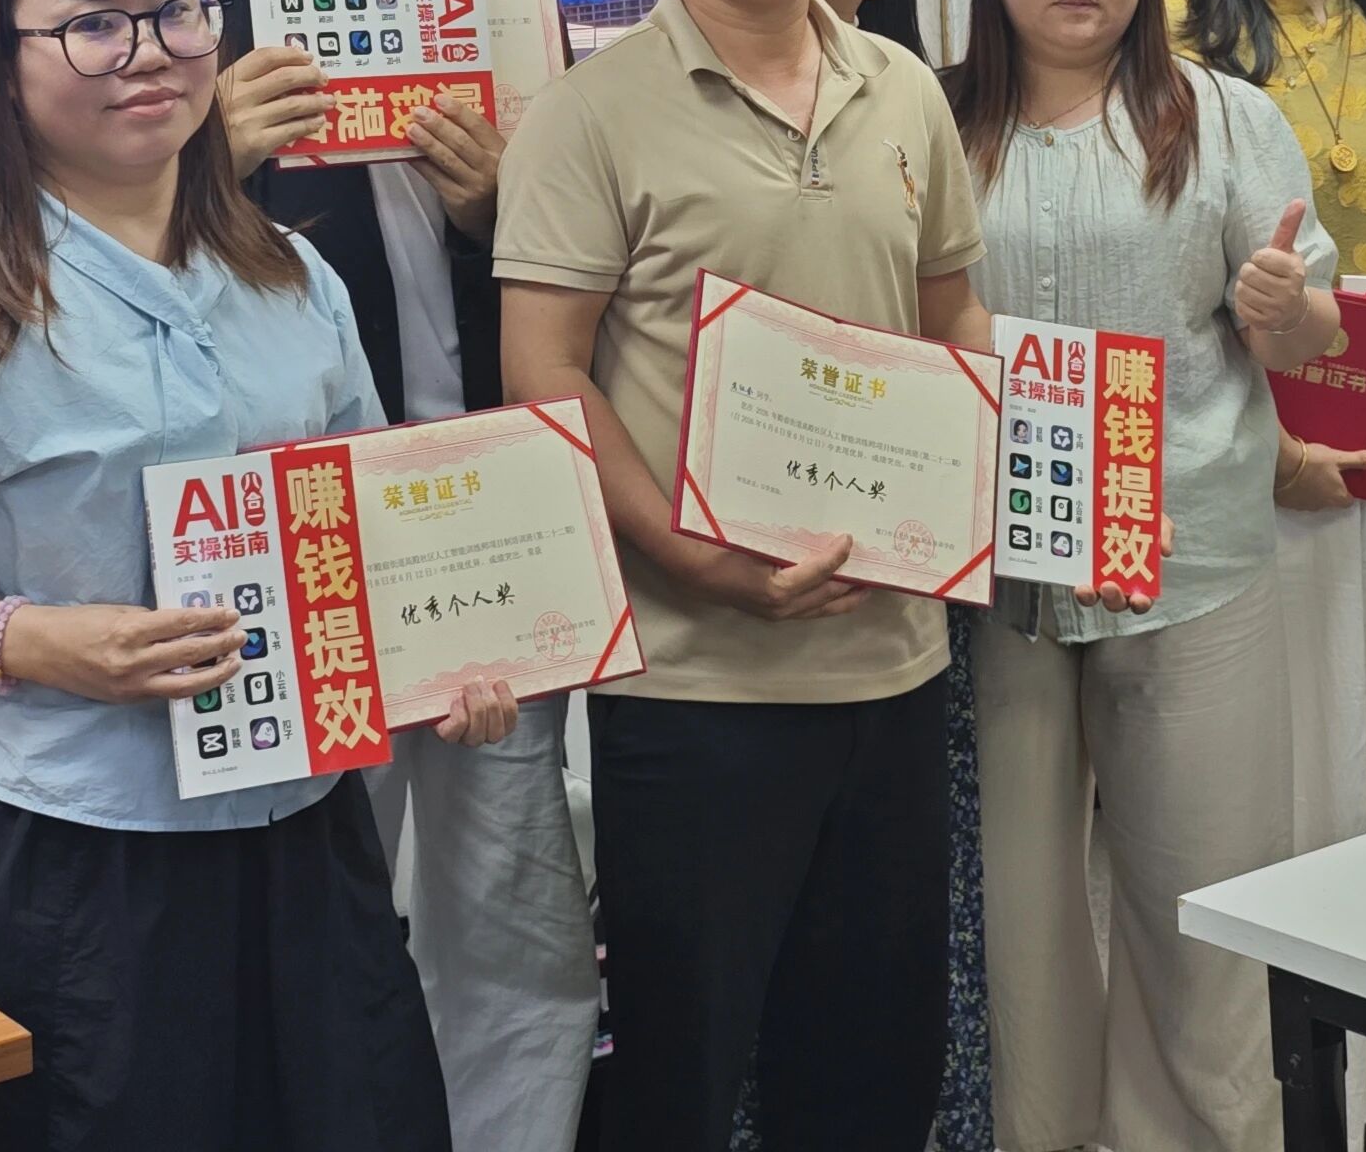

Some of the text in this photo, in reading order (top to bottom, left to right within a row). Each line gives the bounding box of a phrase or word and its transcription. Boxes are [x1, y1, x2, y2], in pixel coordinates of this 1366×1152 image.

[800, 357, 887, 400] 荣誉证书
[1010, 333, 1063, 382] AI
[1068, 341, 1085, 384] 八合一
[1008, 377, 1085, 408] 实操指南
[787, 460, 887, 502] 优秀个人奖
[1100, 348, 1157, 583] 赚钱提效
[173, 474, 240, 537] AI
[241, 472, 266, 527] 八合一
[384, 470, 481, 510] 荣誉证书
[173, 531, 270, 566] 实操指南
[285, 462, 382, 755] 赚钱提效
[401, 582, 516, 626] 优秀个人奖
